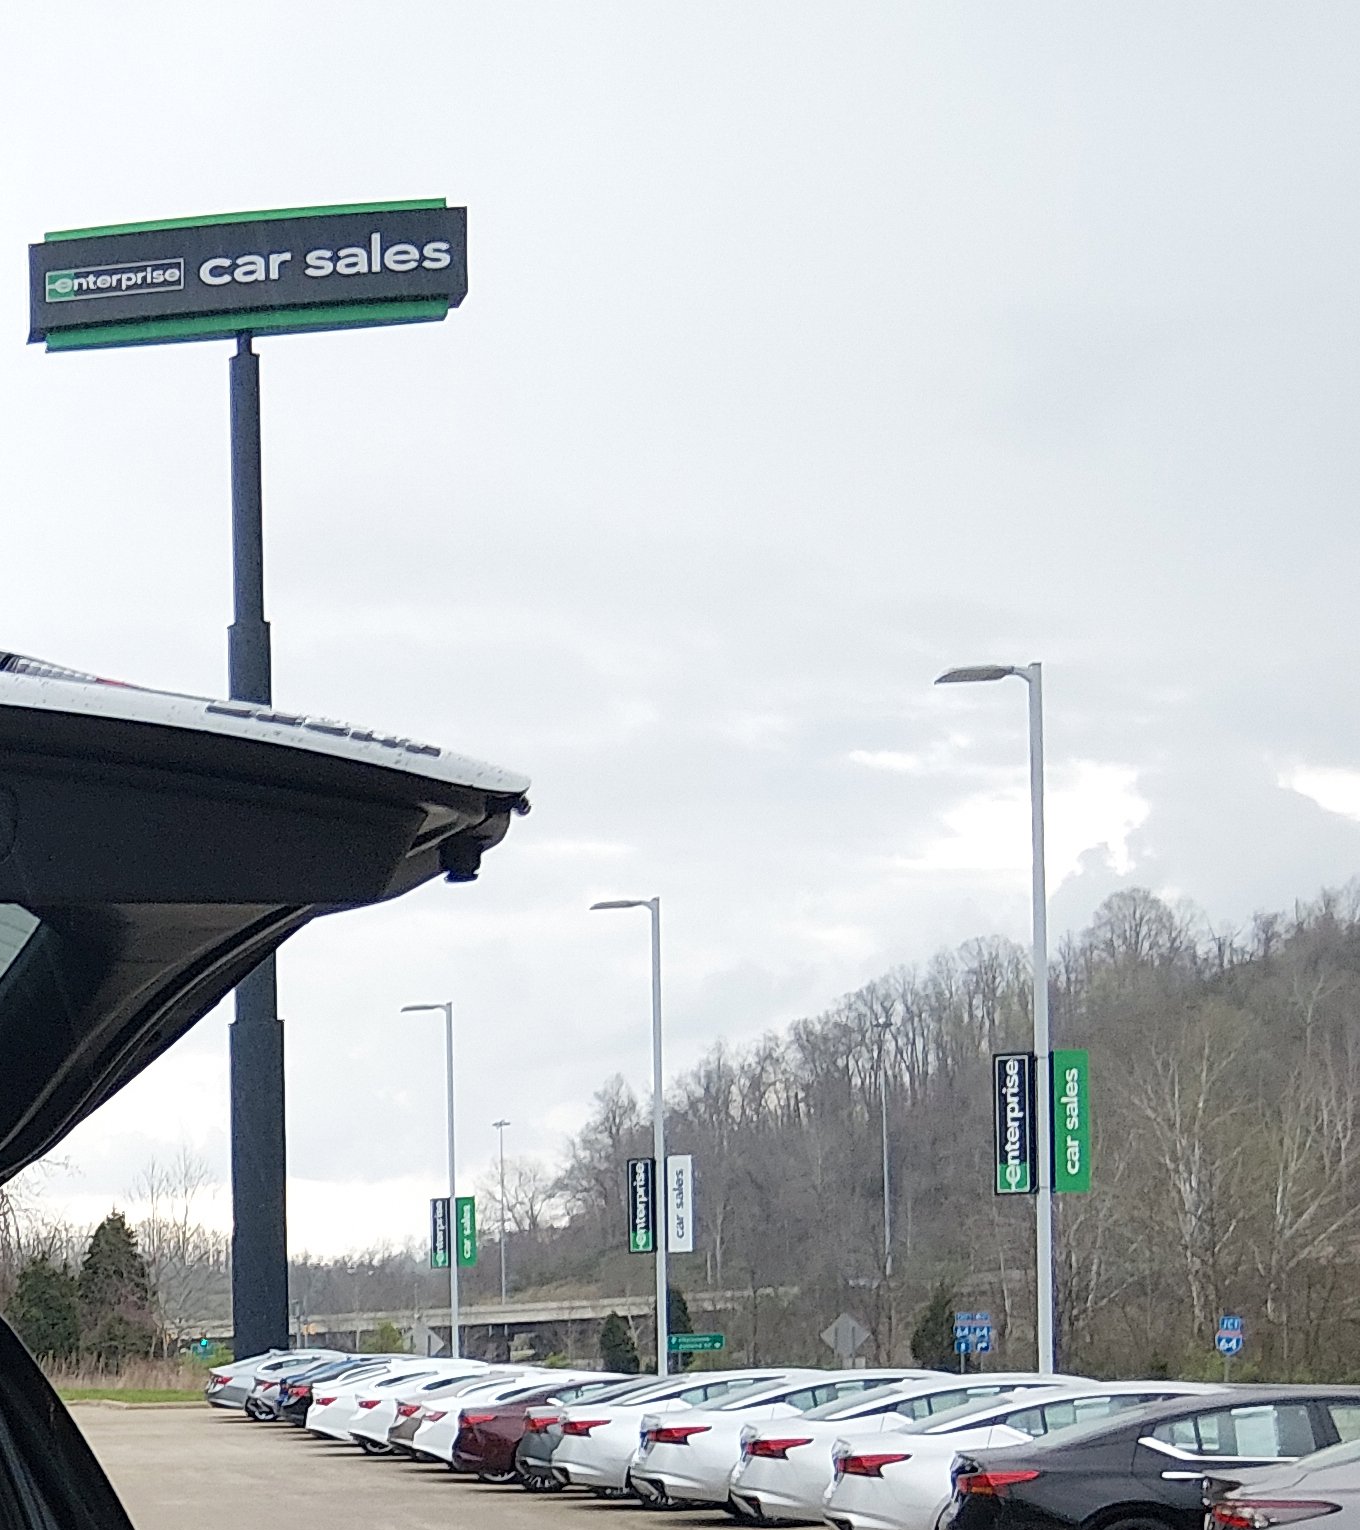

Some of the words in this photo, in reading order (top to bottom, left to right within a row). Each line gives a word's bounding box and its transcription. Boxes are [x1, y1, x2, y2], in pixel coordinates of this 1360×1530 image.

[47, 264, 181, 296] enterprise
[198, 250, 292, 287] car
[303, 232, 452, 278] sales
[1001, 1057, 1024, 1191] enterprise
[1060, 1067, 1079, 1131] sales
[1066, 1134, 1080, 1175] car
[676, 1214, 685, 1239] car
